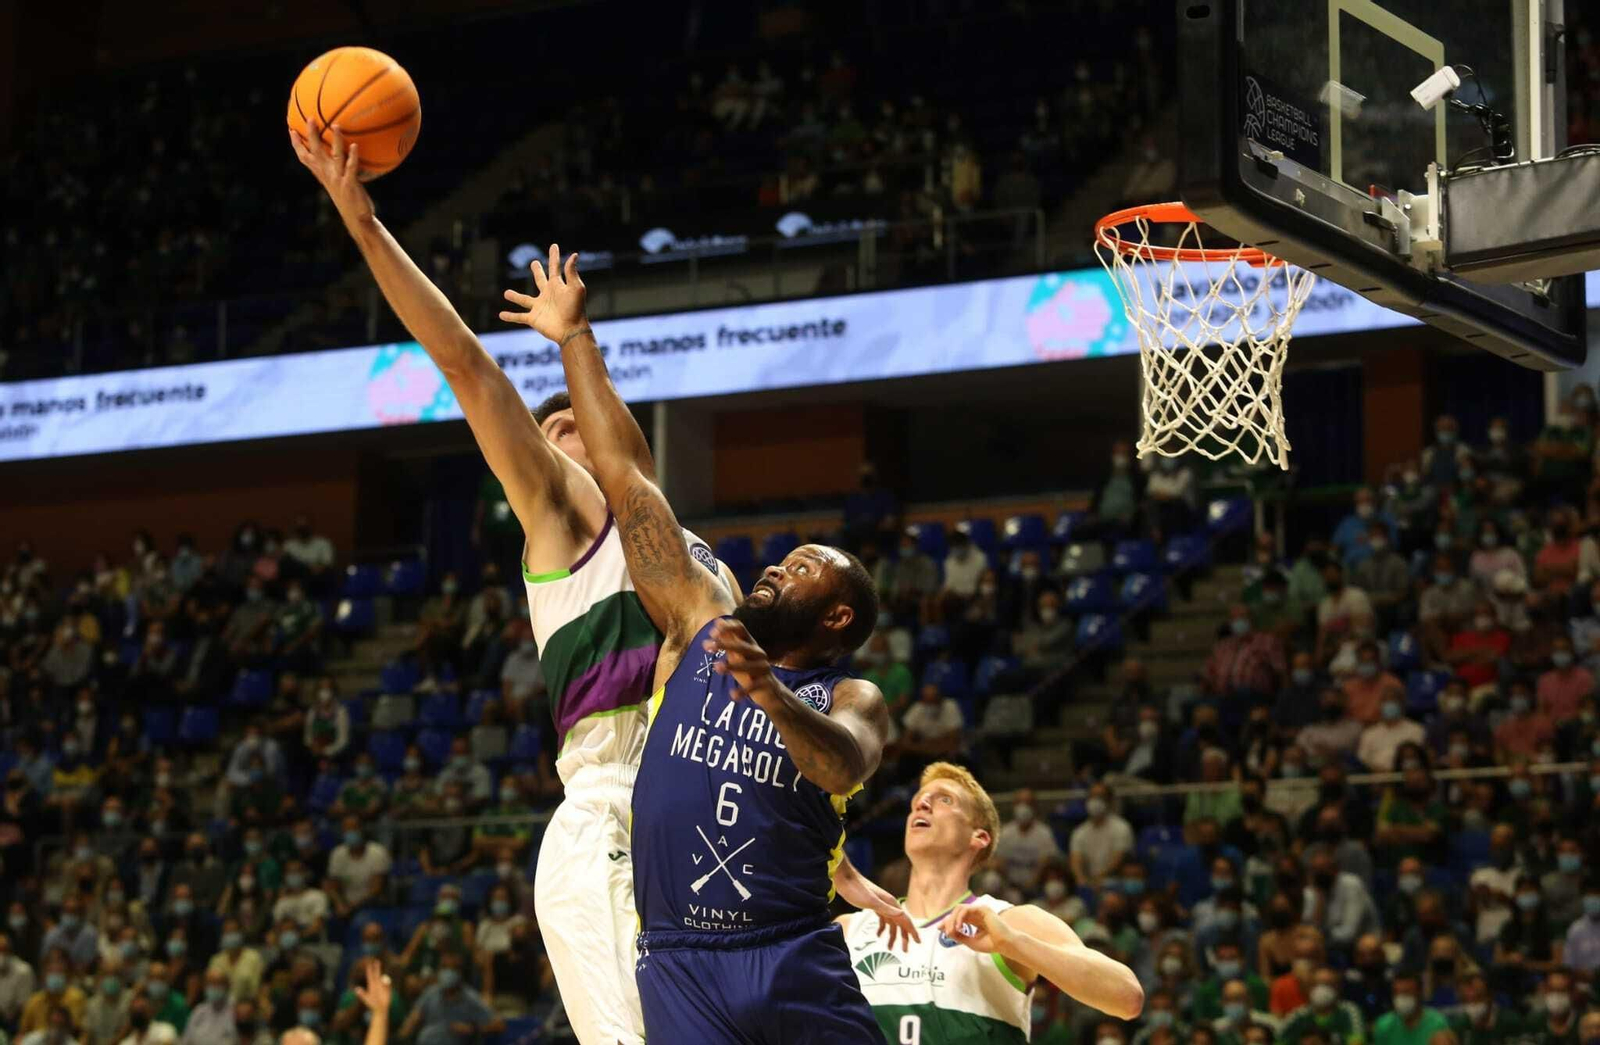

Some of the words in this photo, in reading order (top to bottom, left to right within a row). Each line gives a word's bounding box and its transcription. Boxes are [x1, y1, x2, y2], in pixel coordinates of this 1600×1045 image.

[1266, 94, 1312, 127] BASKETBALL
[1266, 109, 1318, 147] CHAMPIONS
[1266, 126, 1296, 151] LEAGUE
[619, 332, 707, 358] manos
[716, 317, 848, 346] frecuente
[97, 384, 206, 411] frecuente
[716, 781, 743, 827] 6
[688, 903, 753, 922] VINYL
[900, 1015, 920, 1045] 9
